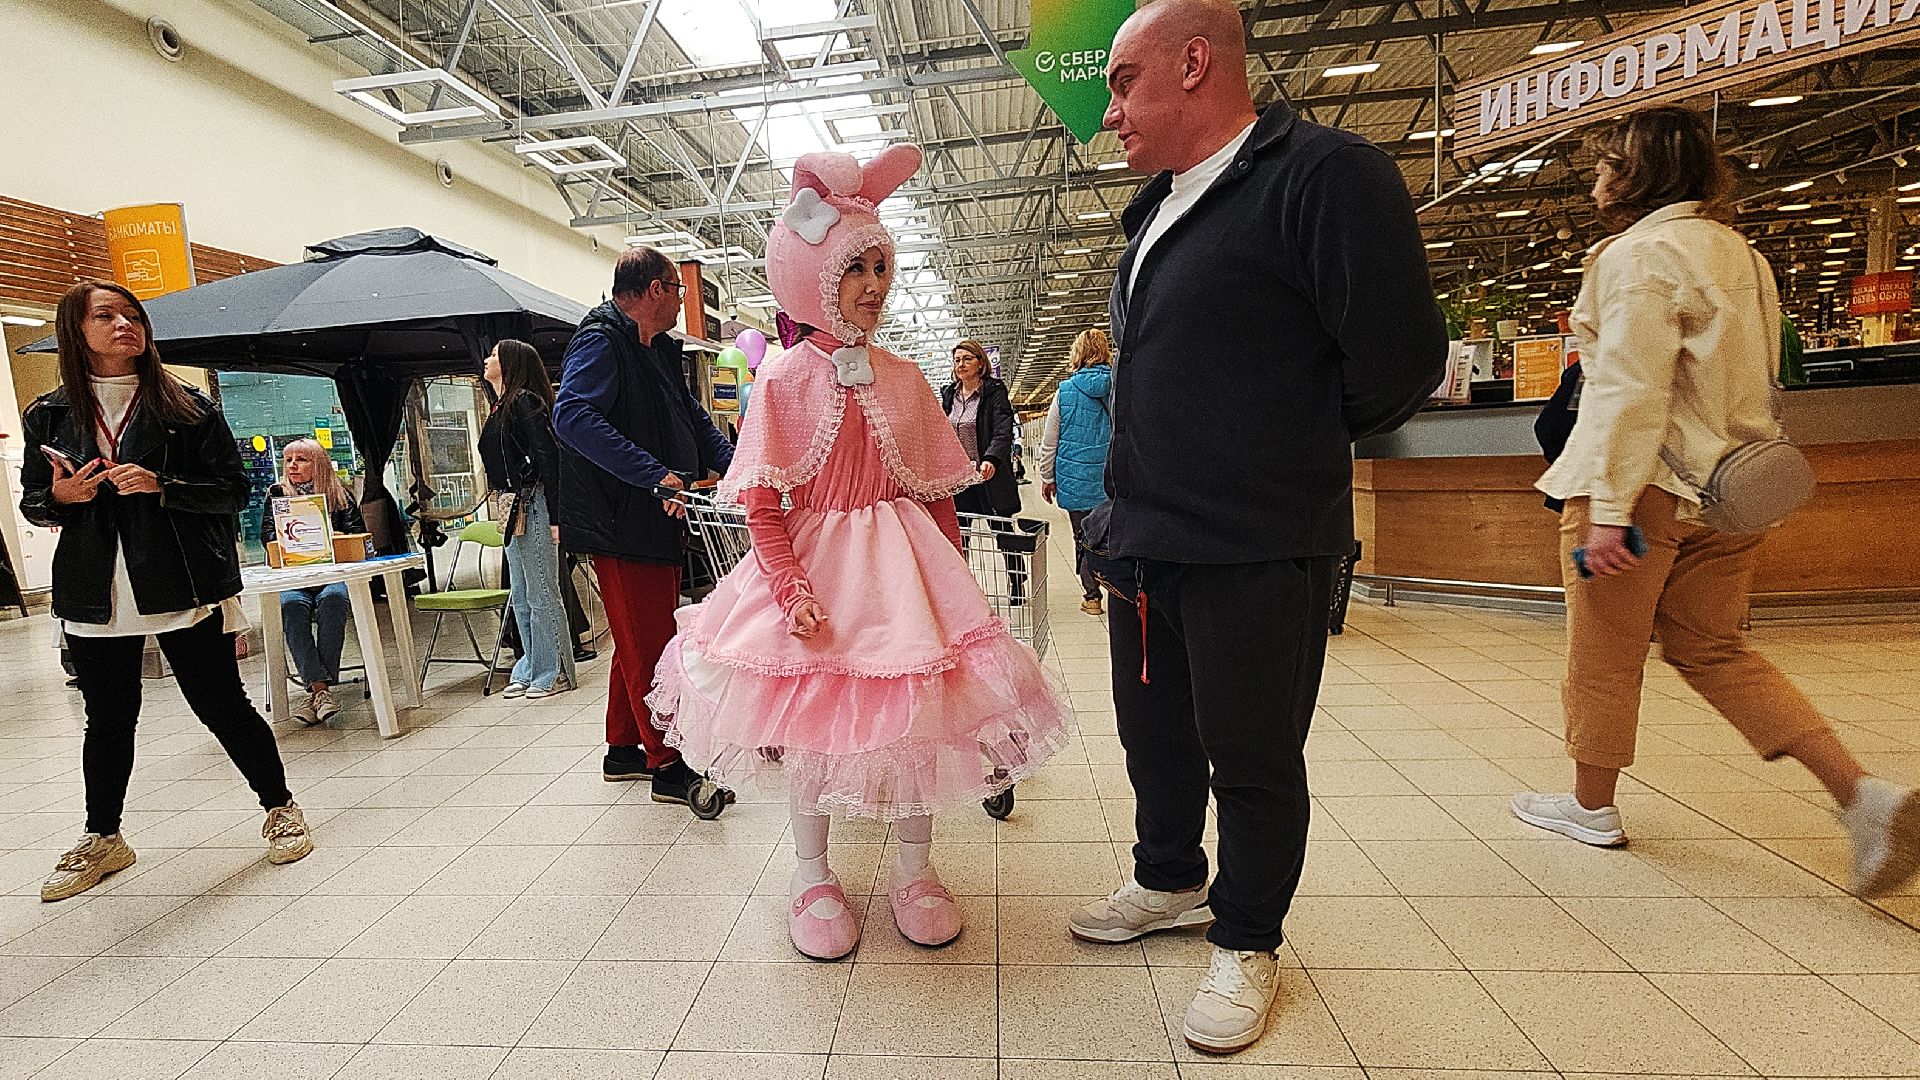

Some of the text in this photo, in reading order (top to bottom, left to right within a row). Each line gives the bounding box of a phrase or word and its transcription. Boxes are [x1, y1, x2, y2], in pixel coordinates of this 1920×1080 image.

[1060, 50, 1106, 67] СБЕР
[108, 220, 177, 241] БАНКОМАТЫ
[1879, 290, 1910, 301] ОБУВЬ
